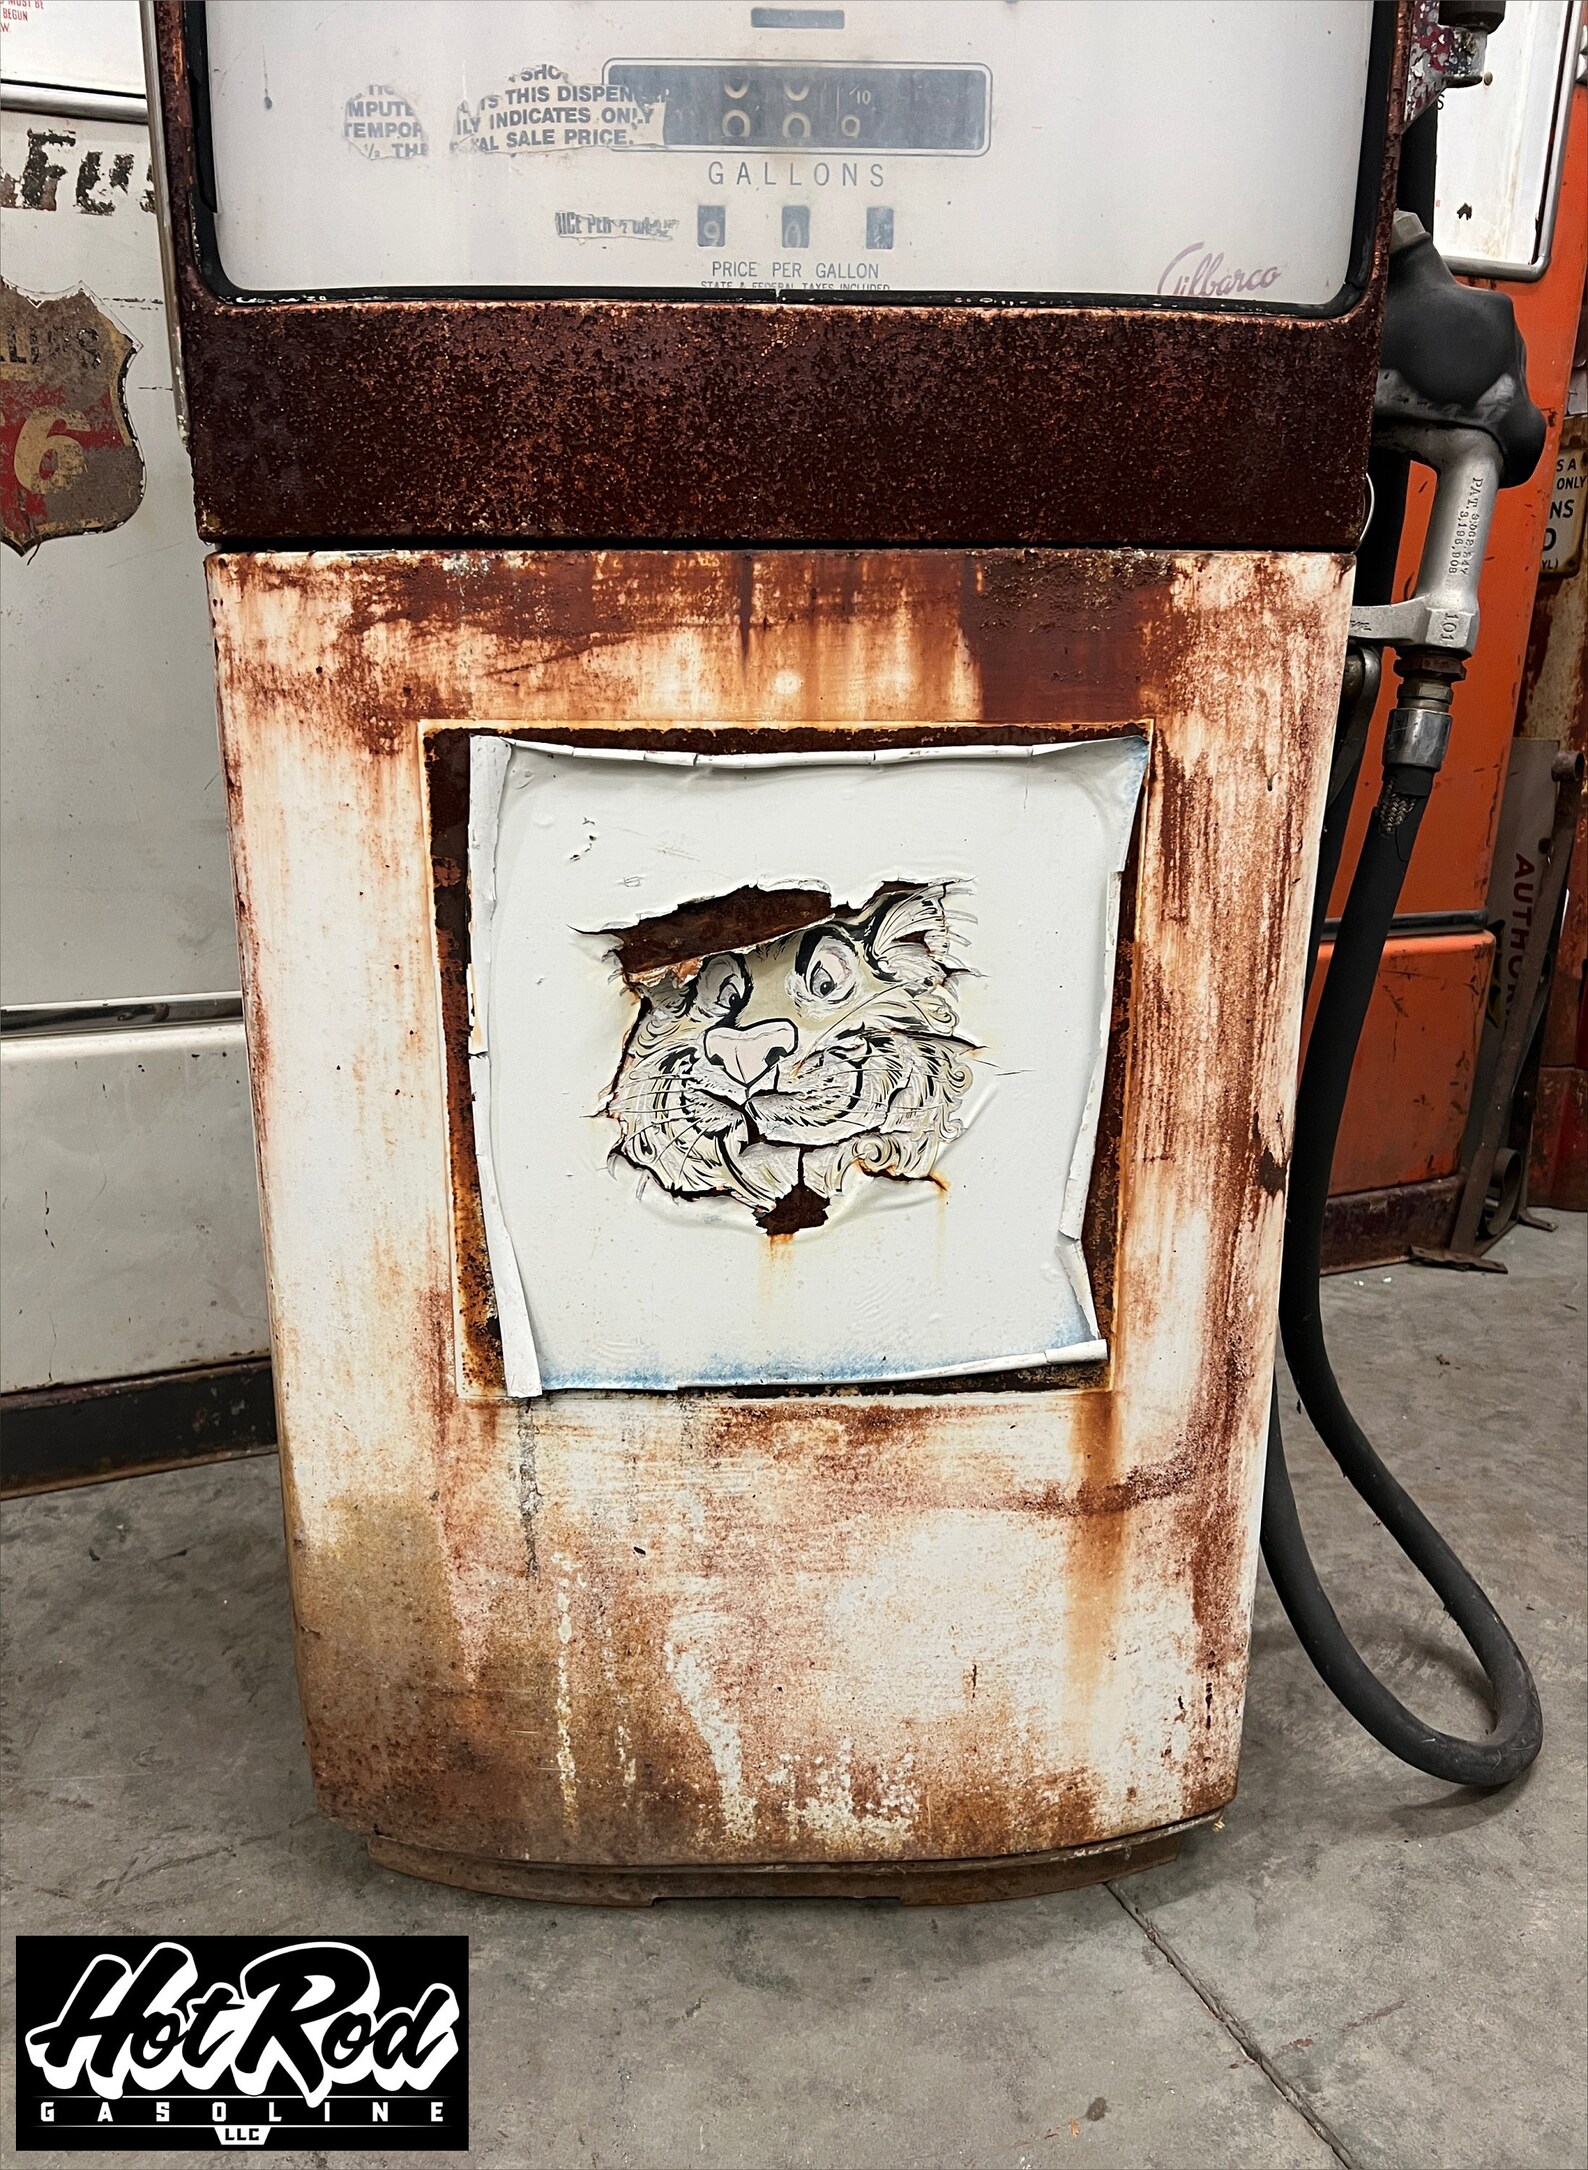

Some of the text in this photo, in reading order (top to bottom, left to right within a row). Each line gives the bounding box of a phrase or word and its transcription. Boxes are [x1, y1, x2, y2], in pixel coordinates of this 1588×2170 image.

[3, 8, 28, 22] BEGUN
[505, 86, 550, 105] THIS
[490, 107, 591, 130] INDICATES
[506, 129, 556, 148] SALE
[564, 128, 634, 146] PRICE.
[708, 160, 885, 187] GALLONS
[712, 261, 879, 279] PRICE PER GALLON
[1556, 475, 1587, 490] ONLY
[1440, 611, 1460, 642] 101
